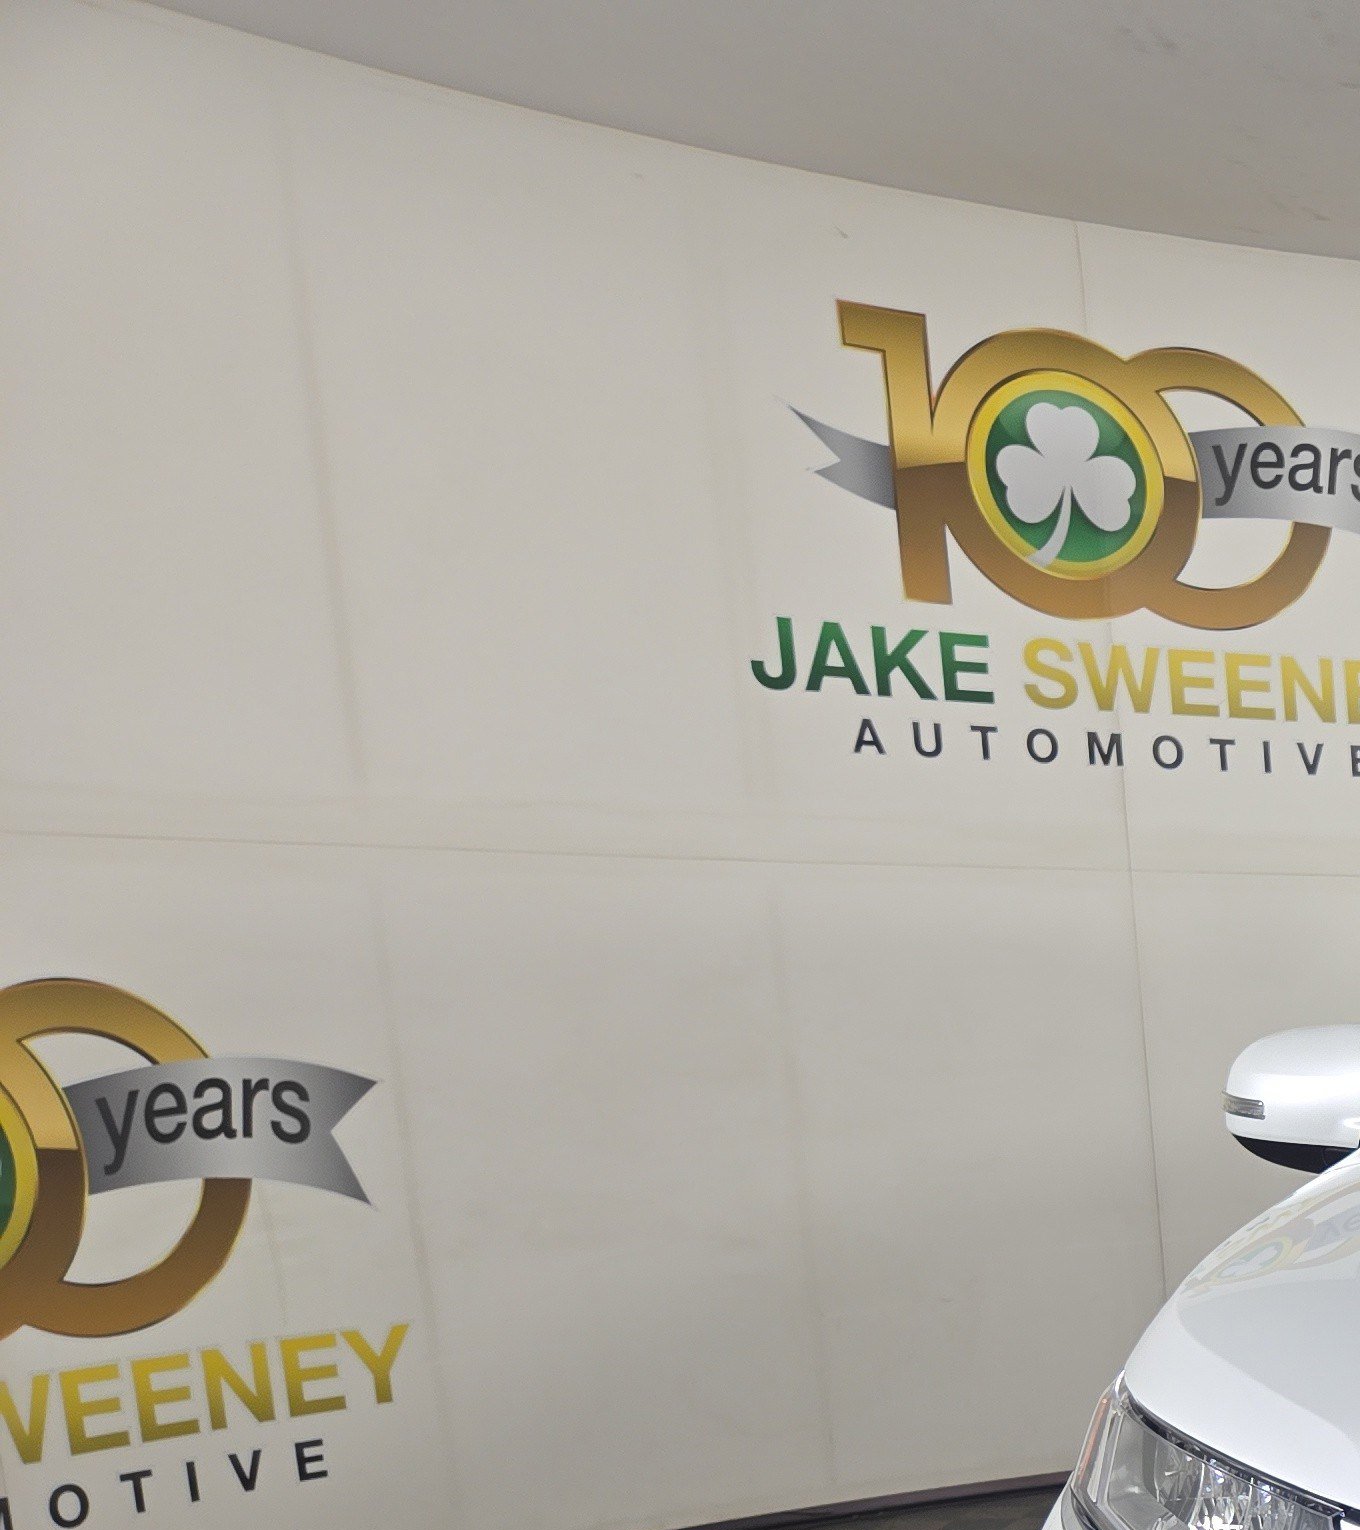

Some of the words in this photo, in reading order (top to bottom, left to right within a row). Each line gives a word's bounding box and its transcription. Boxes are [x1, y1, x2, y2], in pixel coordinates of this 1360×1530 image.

[835, 298, 1332, 632] 100
[750, 616, 996, 705] JAKE
[95, 1076, 312, 1176] years
